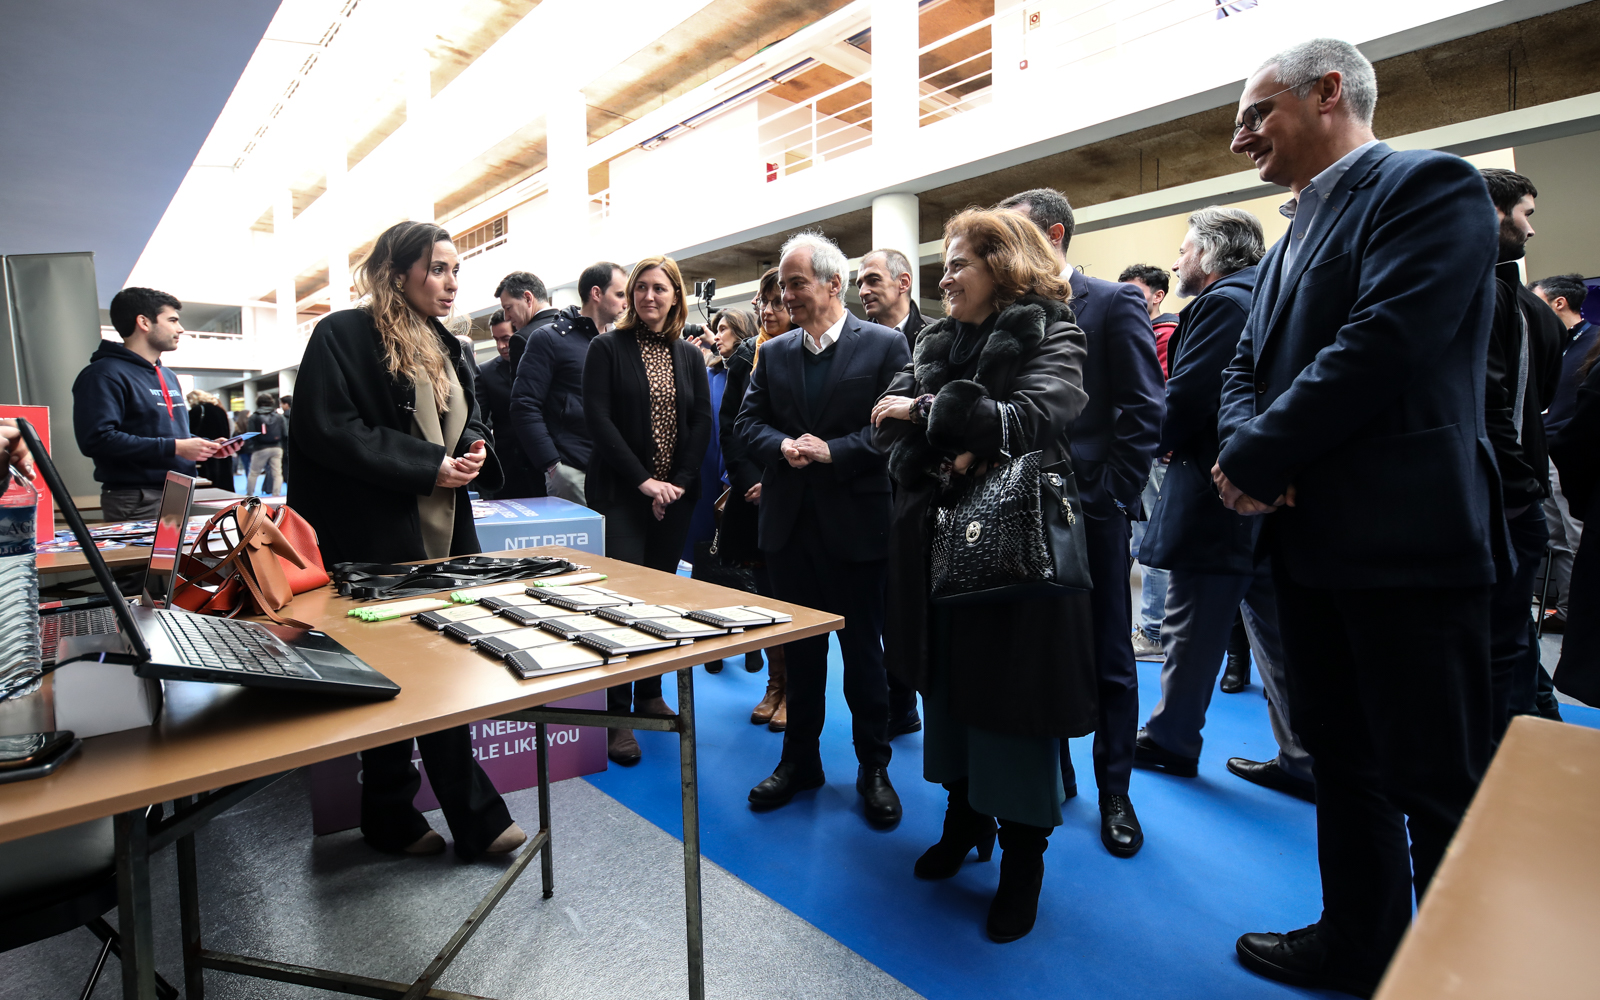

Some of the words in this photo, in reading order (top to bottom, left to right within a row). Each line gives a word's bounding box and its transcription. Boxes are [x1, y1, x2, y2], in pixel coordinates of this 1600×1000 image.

[505, 536, 540, 550] NTT
[504, 736, 537, 755] LIKE
[547, 728, 580, 747] YOU
